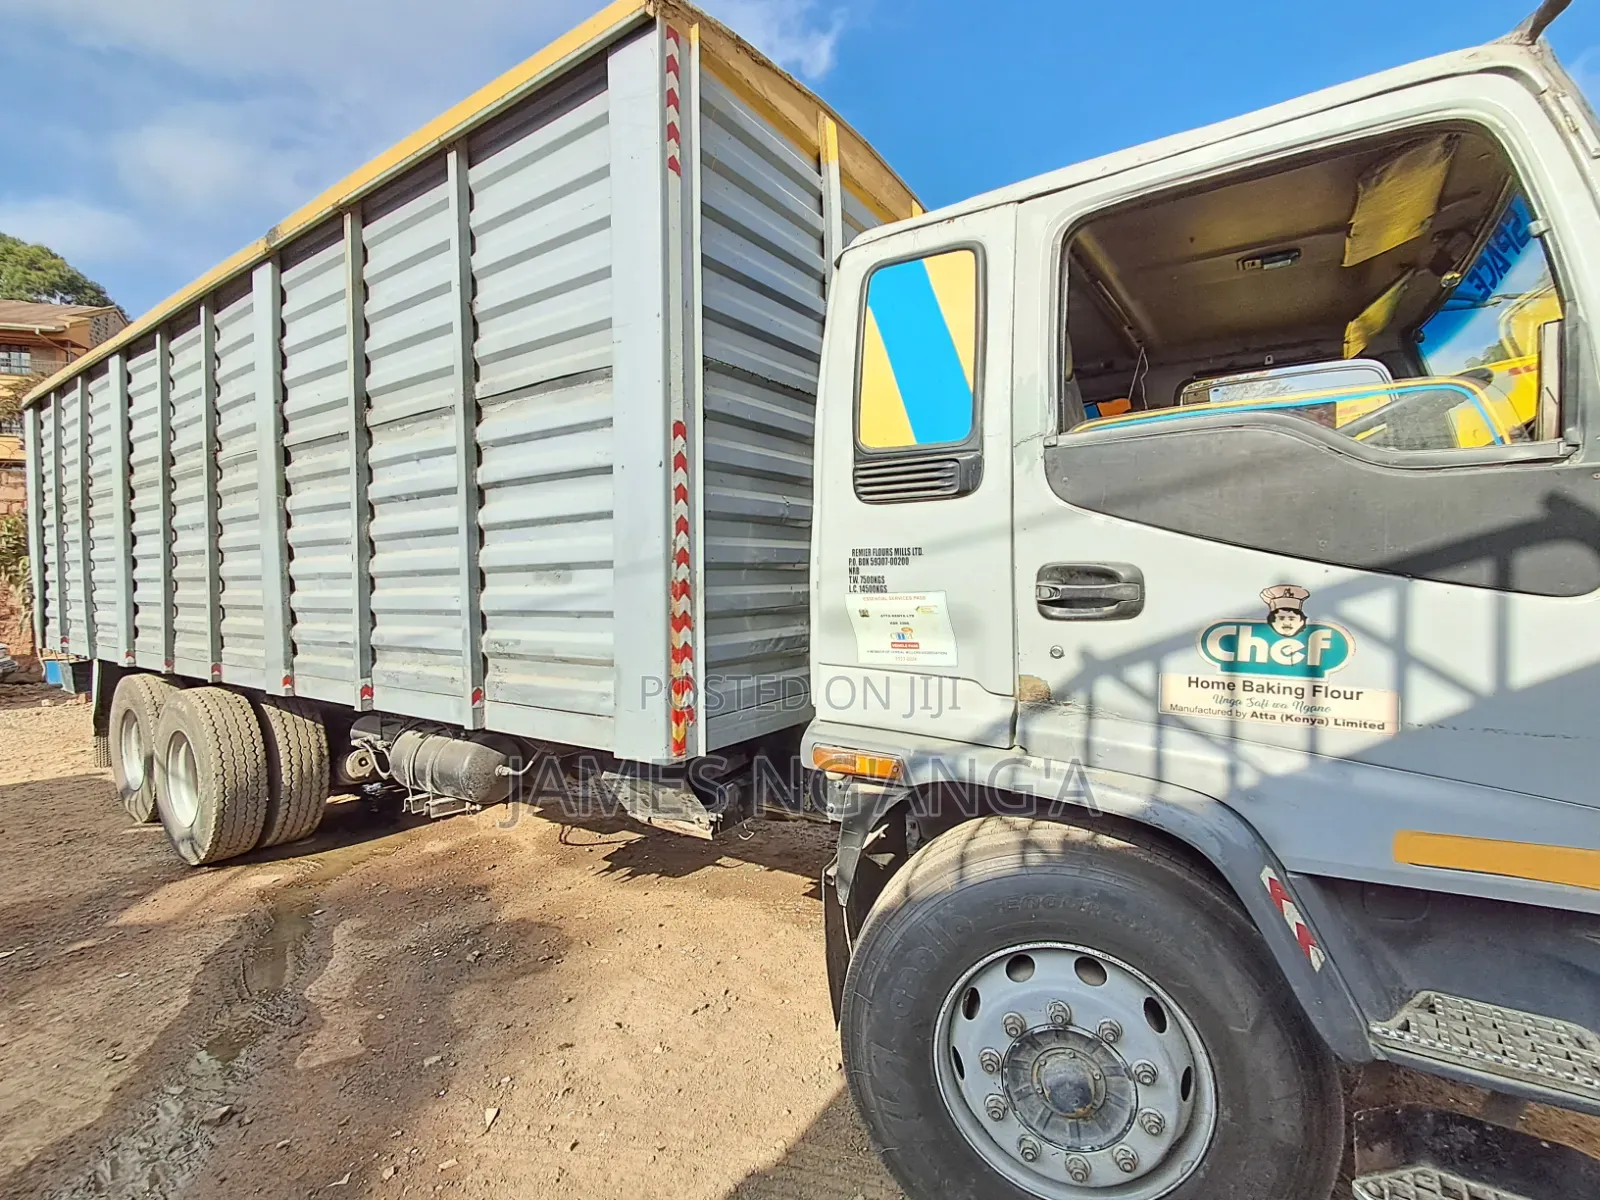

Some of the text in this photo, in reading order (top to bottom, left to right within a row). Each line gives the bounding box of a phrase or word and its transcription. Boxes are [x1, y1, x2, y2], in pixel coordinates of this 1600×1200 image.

[872, 548, 892, 556] FLOURS
[894, 547, 911, 556] MILLS
[859, 558, 869, 566] BOX
[870, 557, 909, 566] 59307-00200
[860, 575, 885, 584] 7500KGS
[859, 585, 887, 593] 14500KGS
[1206, 625, 1333, 666] Chef
[1188, 676, 1364, 701] Home Baking Flour
[1212, 694, 1243, 707] Unga
[1170, 703, 1385, 730] Manufactured by Atta (Kenya) Limited
